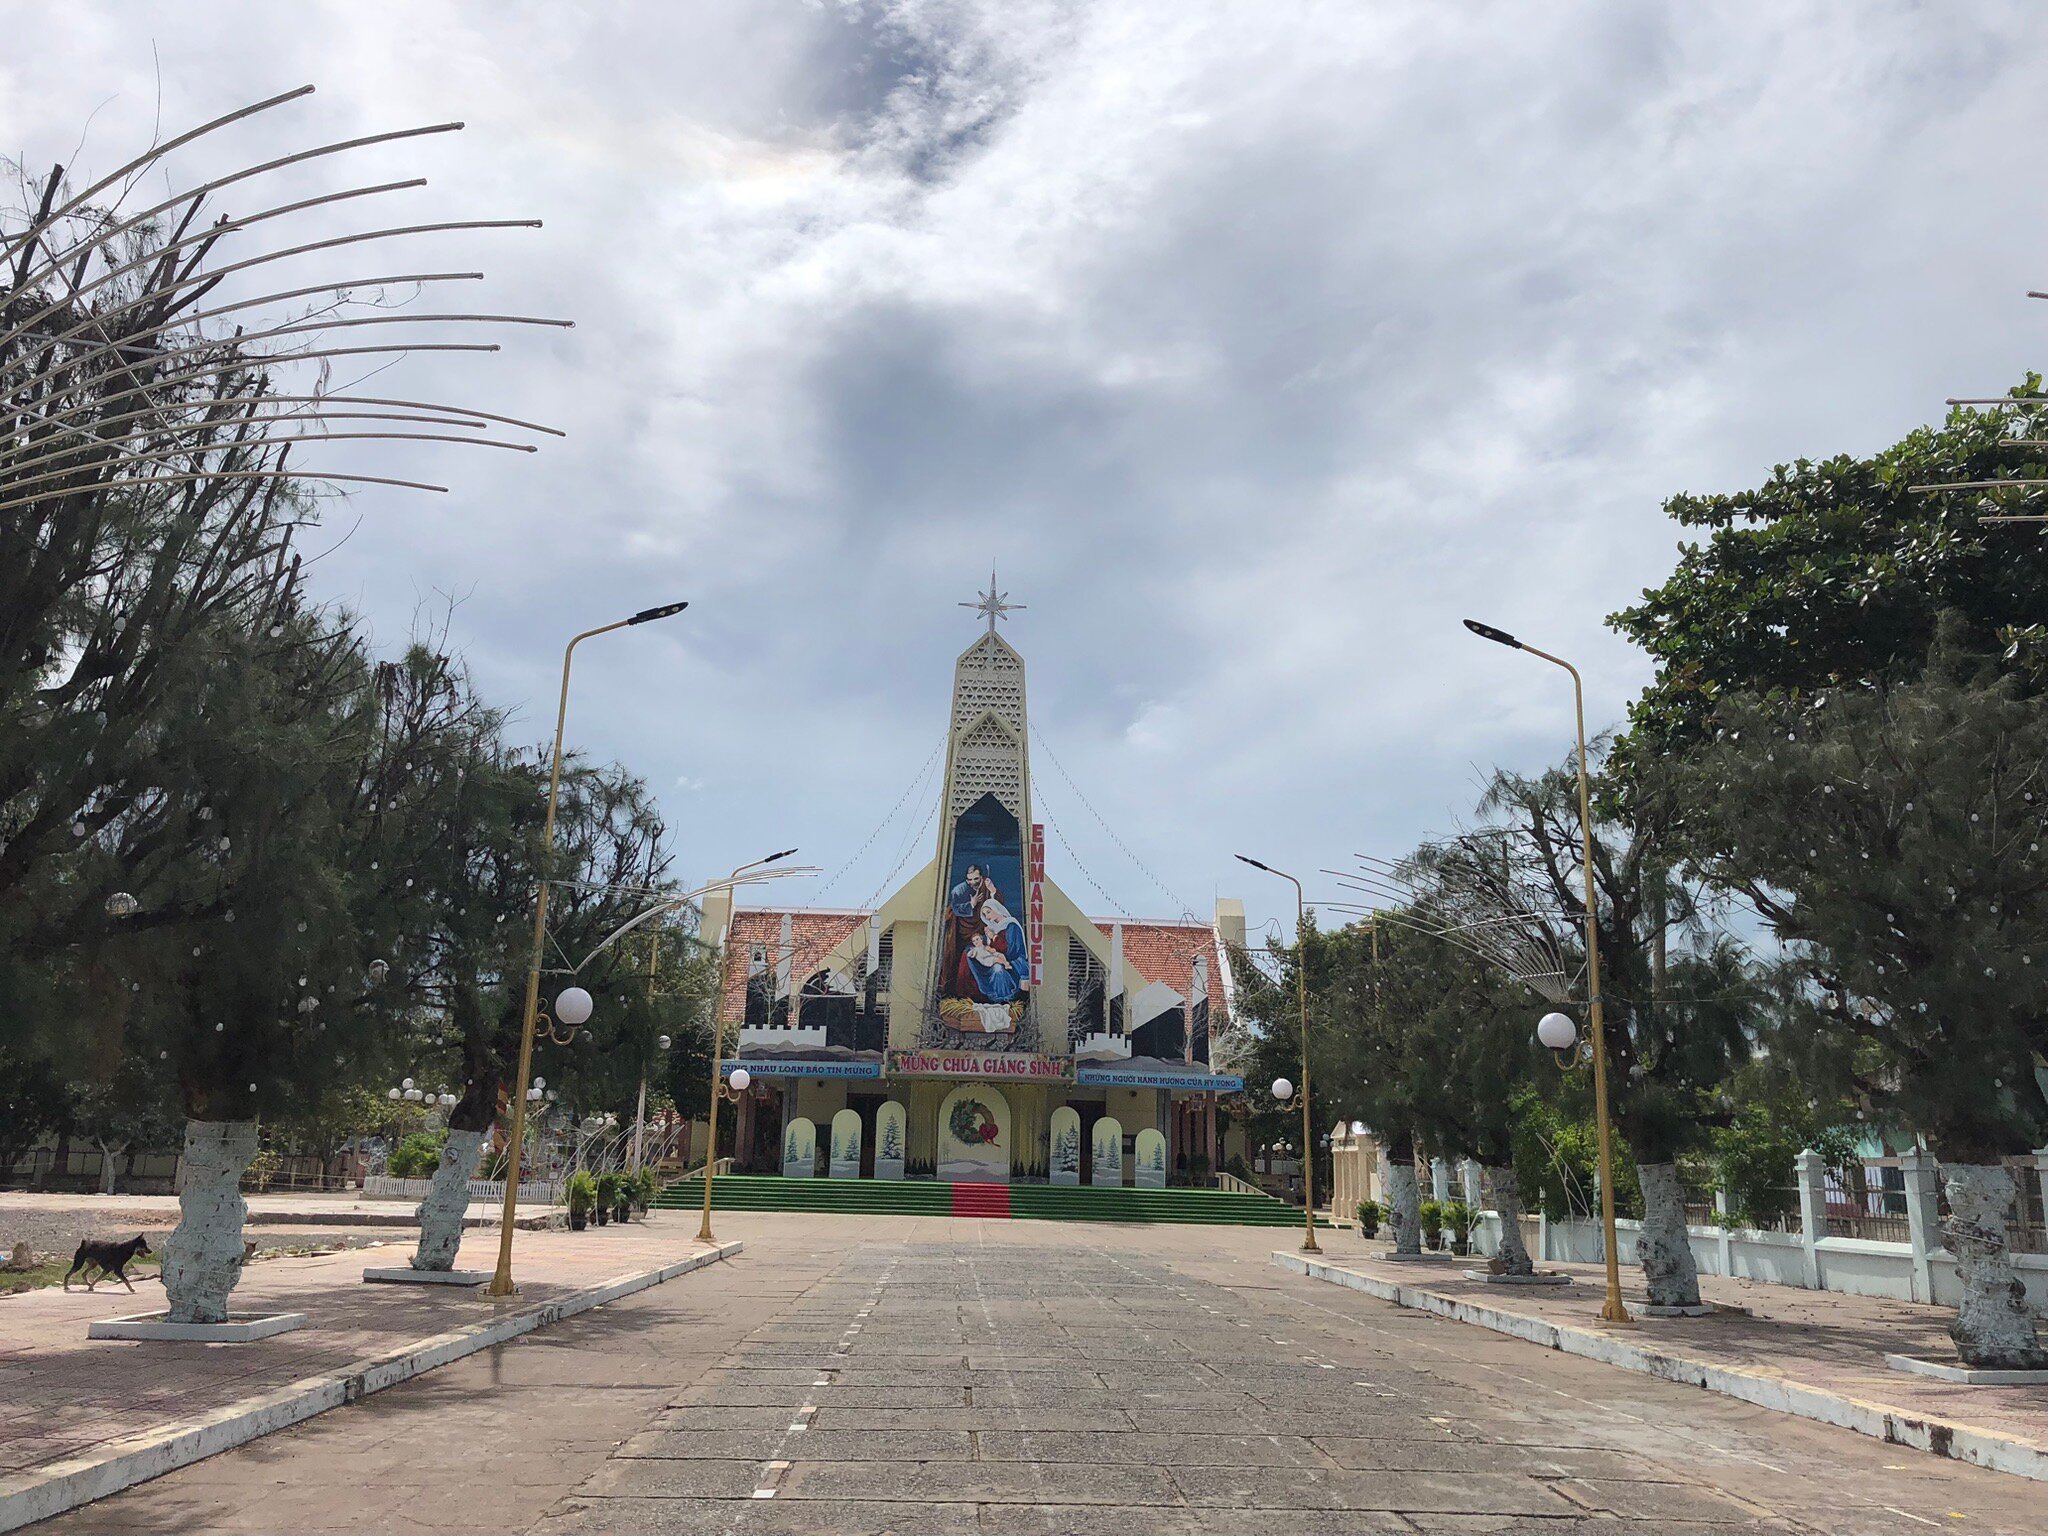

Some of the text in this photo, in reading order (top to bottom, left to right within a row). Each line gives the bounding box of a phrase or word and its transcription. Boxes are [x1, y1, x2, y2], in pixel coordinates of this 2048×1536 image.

[1030, 824, 1045, 986] EMMANUEL
[750, 1065, 777, 1073] NHAU
[779, 1065, 804, 1073] LOAN
[826, 1066, 842, 1074] TIN
[943, 1054, 980, 1073] CHÚA
[983, 1055, 1026, 1074] GIÁNG
[1029, 1060, 1061, 1075] SINH
